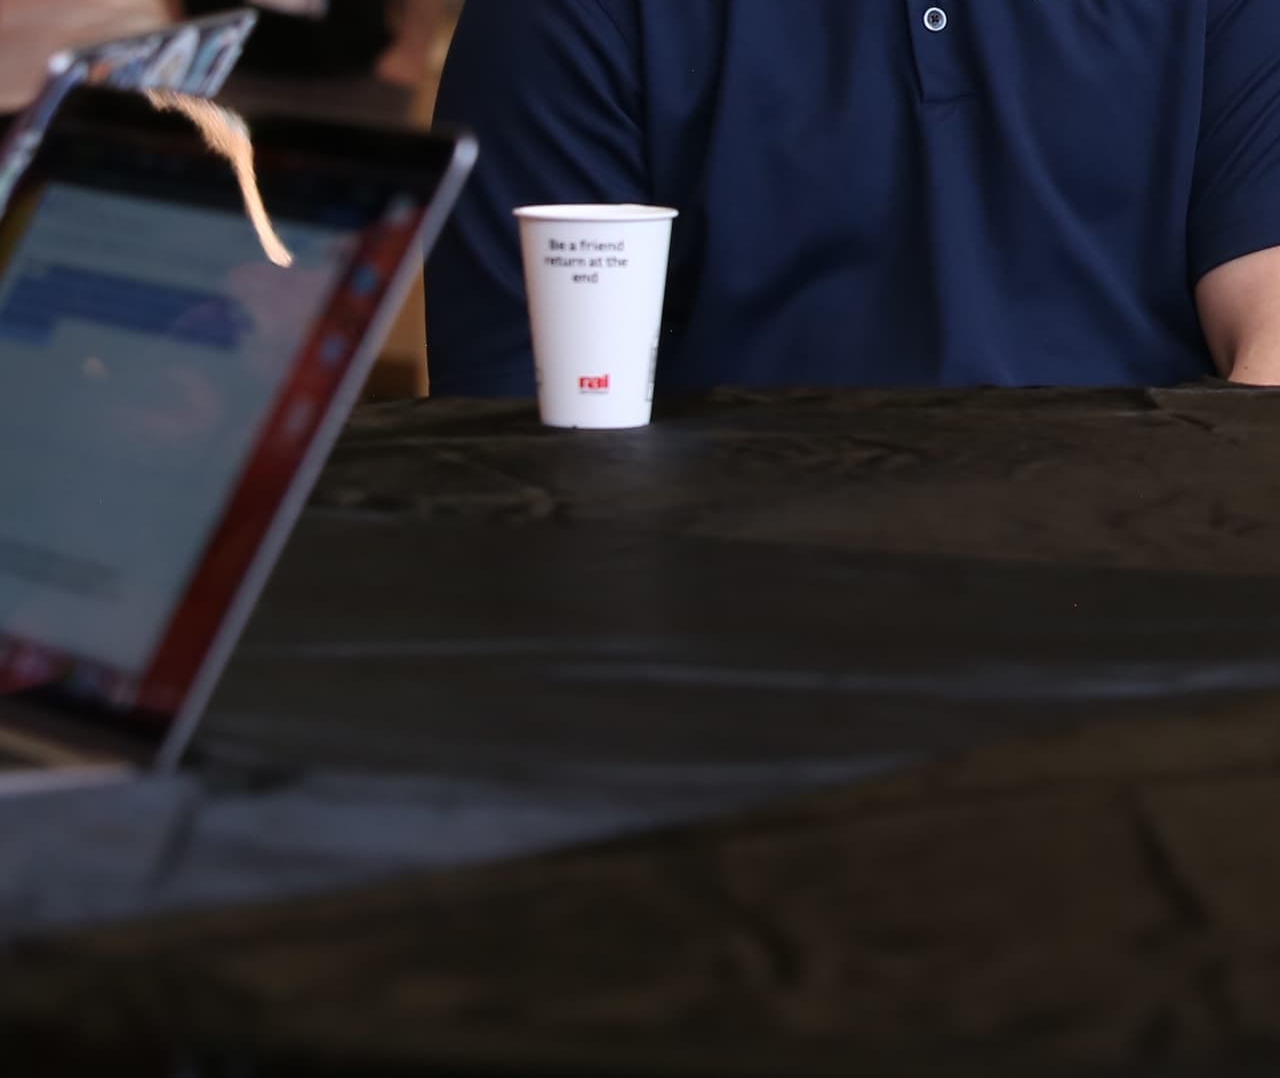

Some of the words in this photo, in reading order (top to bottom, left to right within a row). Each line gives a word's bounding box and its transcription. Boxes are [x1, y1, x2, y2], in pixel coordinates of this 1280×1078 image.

[548, 239, 564, 252] Be
[569, 242, 577, 252] a
[580, 239, 625, 252] friend
[543, 256, 587, 267] return
[590, 256, 602, 267] at
[606, 256, 628, 268] the
[573, 272, 599, 283] end
